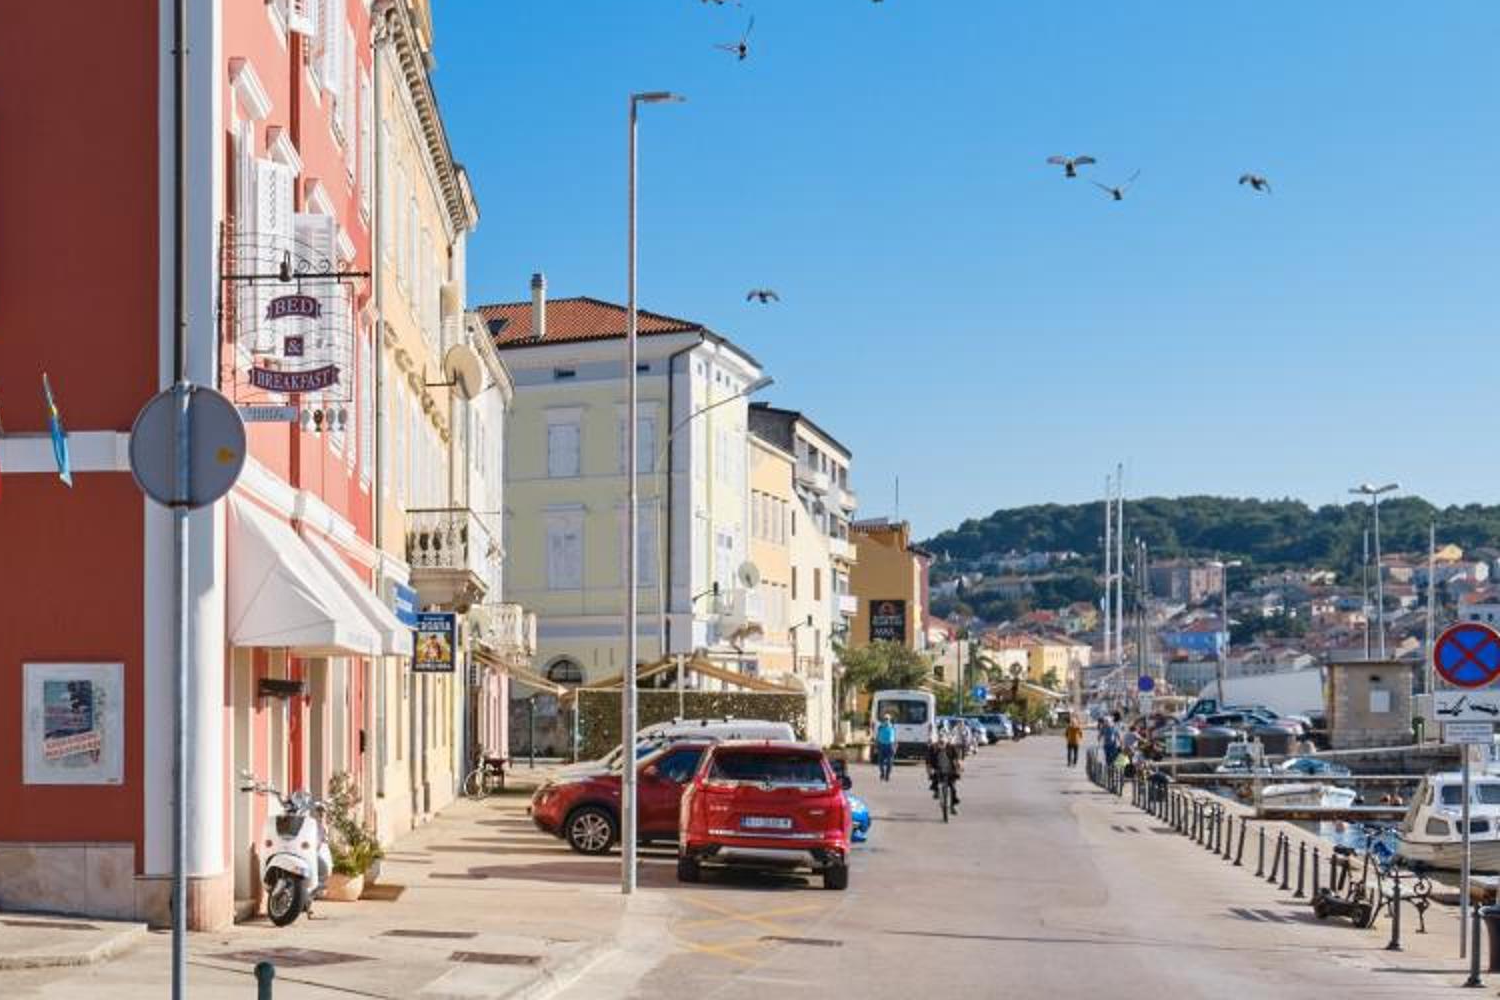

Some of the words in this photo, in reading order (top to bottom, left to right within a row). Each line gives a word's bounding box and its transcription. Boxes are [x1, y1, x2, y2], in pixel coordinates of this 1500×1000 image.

[275, 298, 314, 315] BED
[287, 339, 300, 353] &
[257, 368, 330, 390] BREAKFAST
